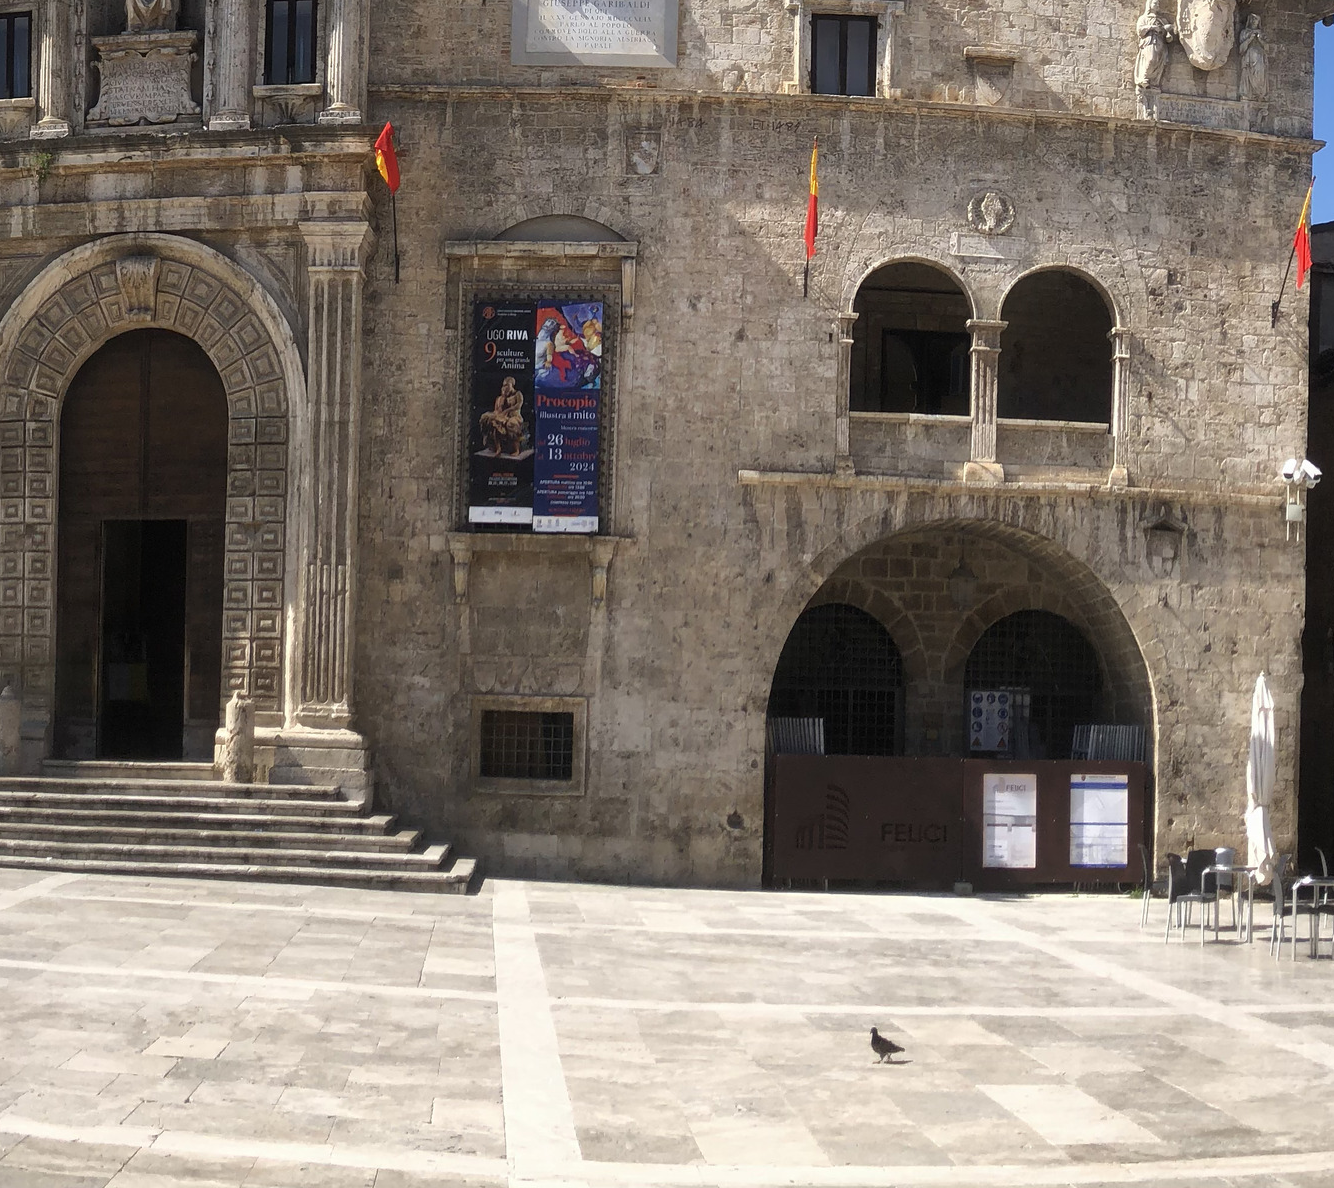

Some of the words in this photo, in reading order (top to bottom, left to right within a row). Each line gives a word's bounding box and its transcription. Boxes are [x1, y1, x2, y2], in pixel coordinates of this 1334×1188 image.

[543, 0, 591, 7] GIUSEPPE
[594, 0, 651, 9] GARIBALDI
[487, 329, 505, 340] UGO
[507, 329, 528, 340] RIVA
[484, 341, 497, 362] 9
[497, 348, 524, 357] sculture
[536, 394, 597, 411] Procopio
[573, 410, 596, 419] mito
[547, 433, 564, 446] 26
[565, 437, 591, 448] luglio
[549, 447, 563, 460] 13
[569, 462, 594, 472] 2024
